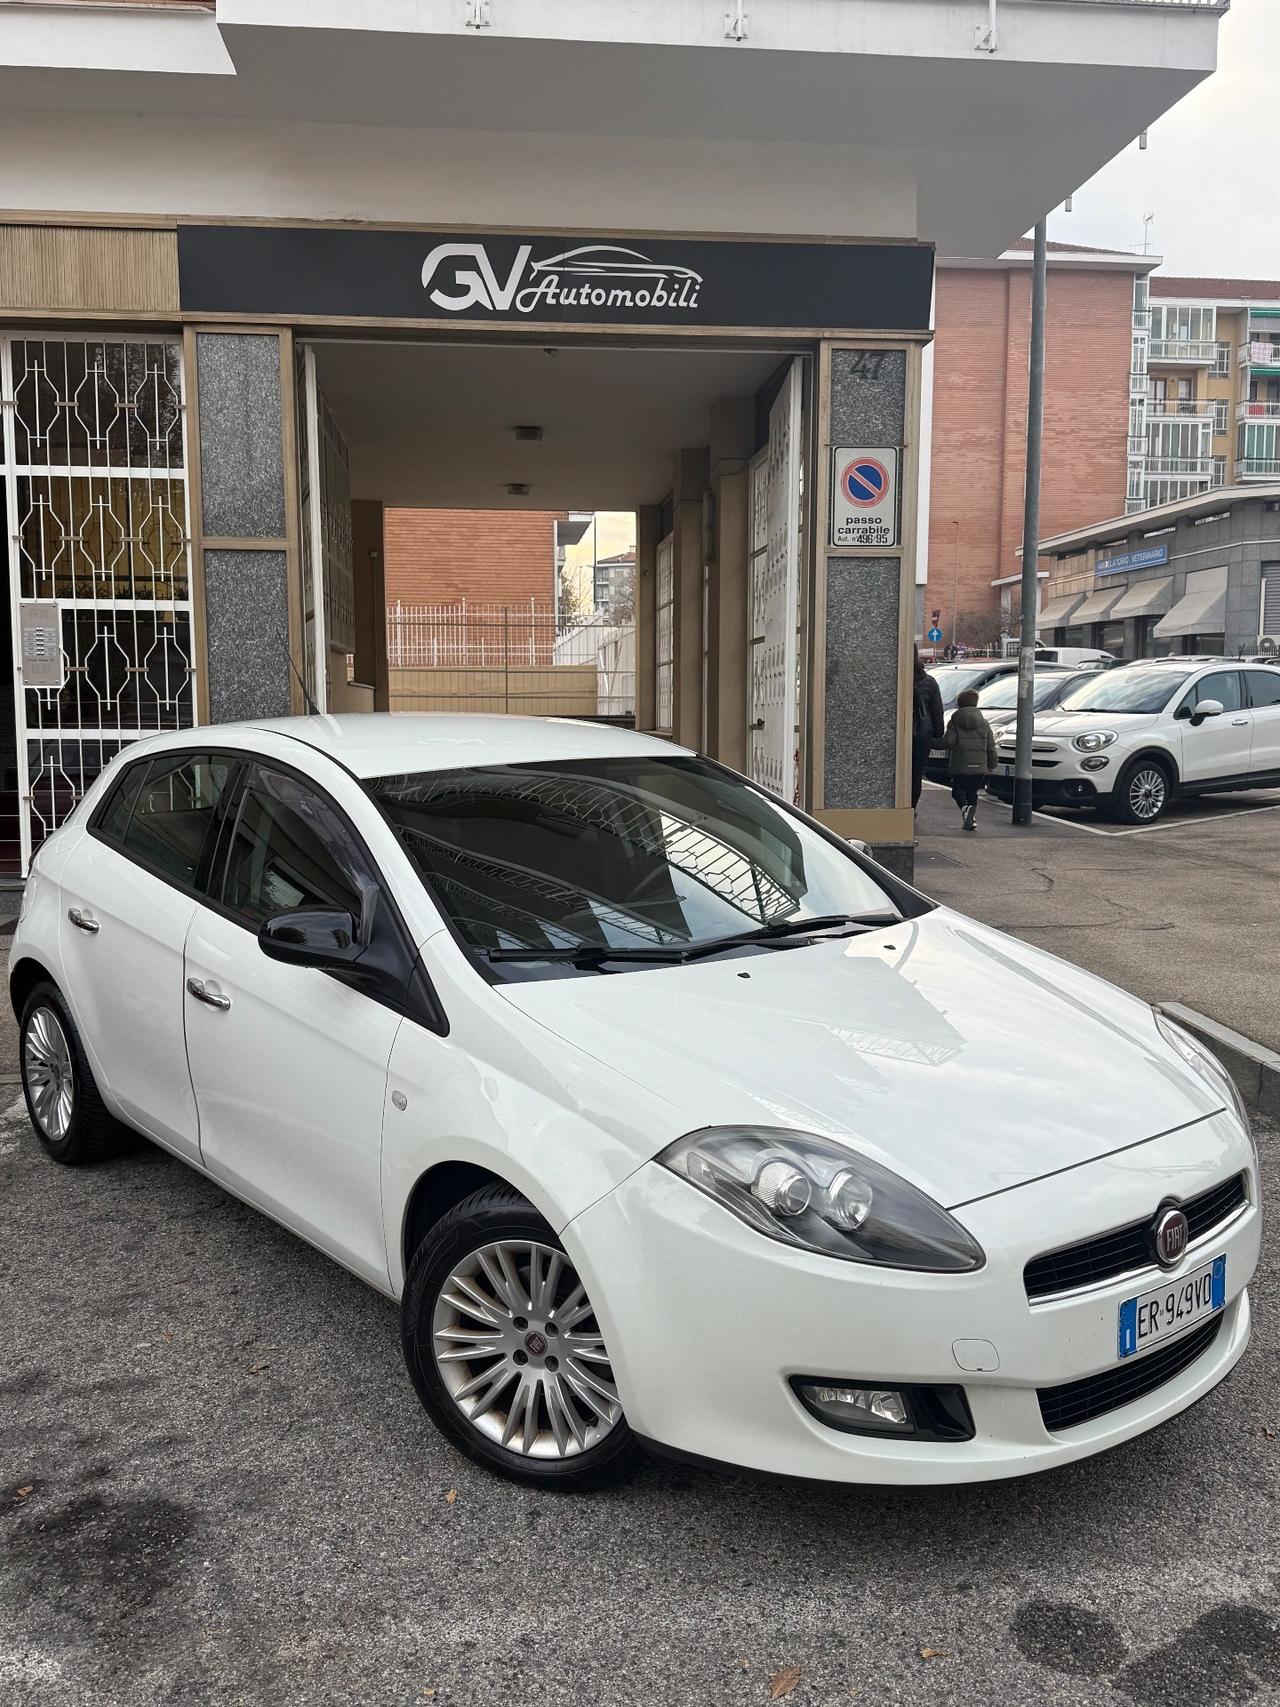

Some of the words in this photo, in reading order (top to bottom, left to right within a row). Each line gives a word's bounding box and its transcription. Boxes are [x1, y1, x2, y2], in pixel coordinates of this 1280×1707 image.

[421, 243, 532, 311] GV
[516, 275, 700, 313] Automobili
[849, 351, 885, 380] 47
[837, 526, 890, 534] carrabile
[846, 517, 882, 526] passo
[1166, 1224, 1184, 1252] FIAT
[1138, 1300, 1160, 1339] ER
[1166, 1273, 1212, 1325] 949VD
